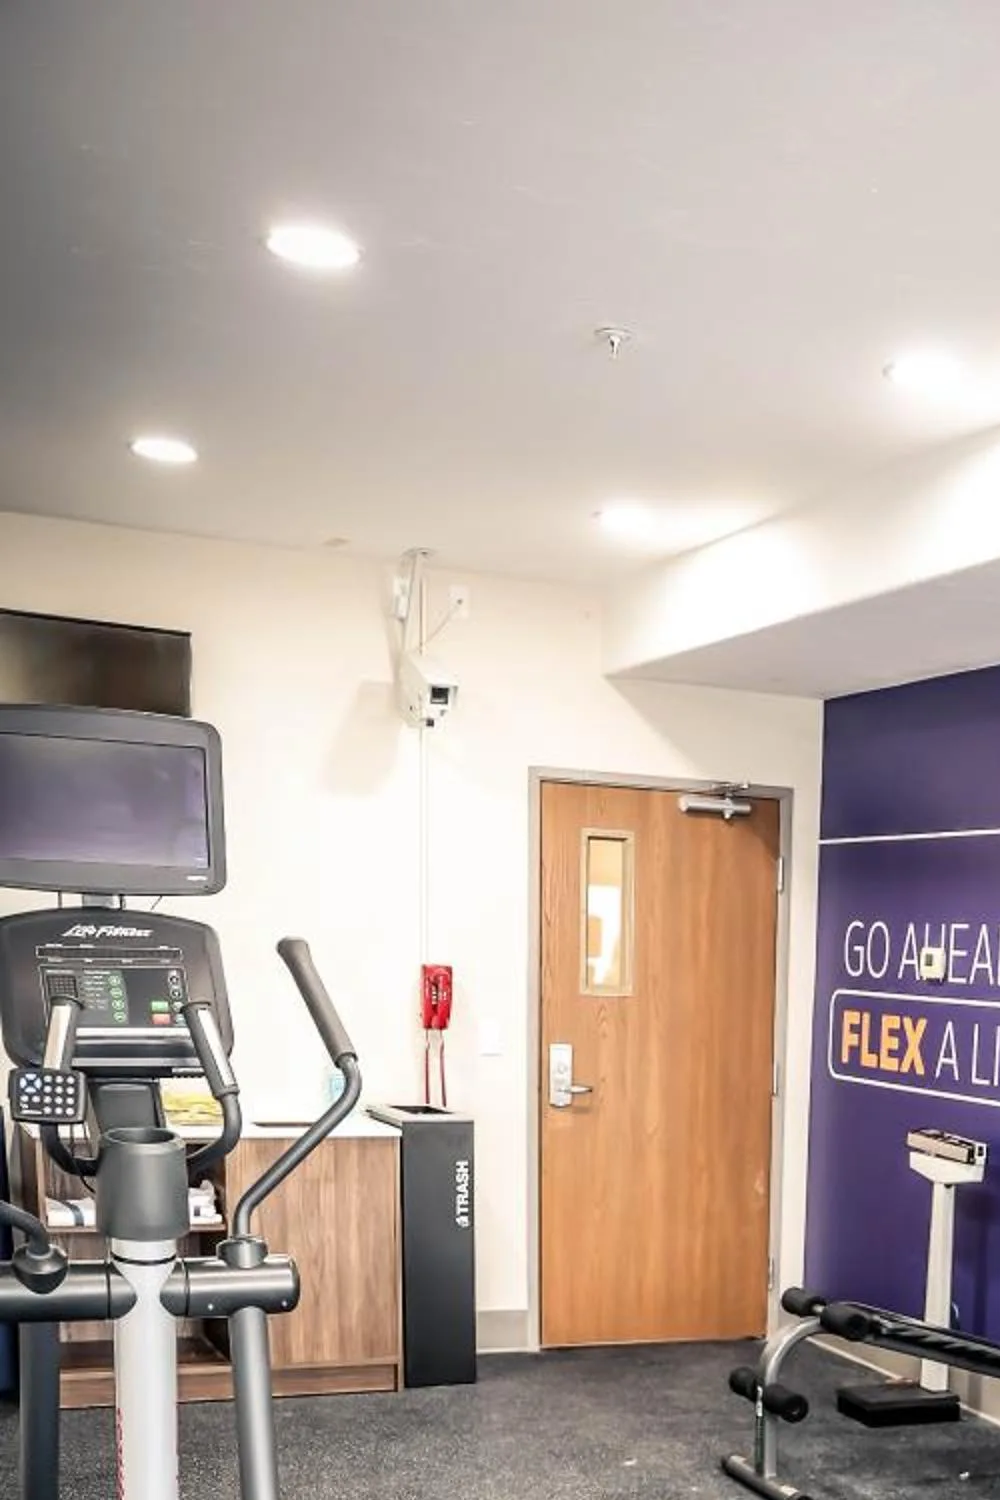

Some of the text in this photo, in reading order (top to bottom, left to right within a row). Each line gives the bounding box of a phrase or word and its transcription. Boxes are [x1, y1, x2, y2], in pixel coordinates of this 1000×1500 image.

[844, 920, 890, 978] GO
[842, 1009, 928, 1076] FLEX
[935, 1021, 960, 1080] A
[455, 1161, 469, 1215] TRASH
